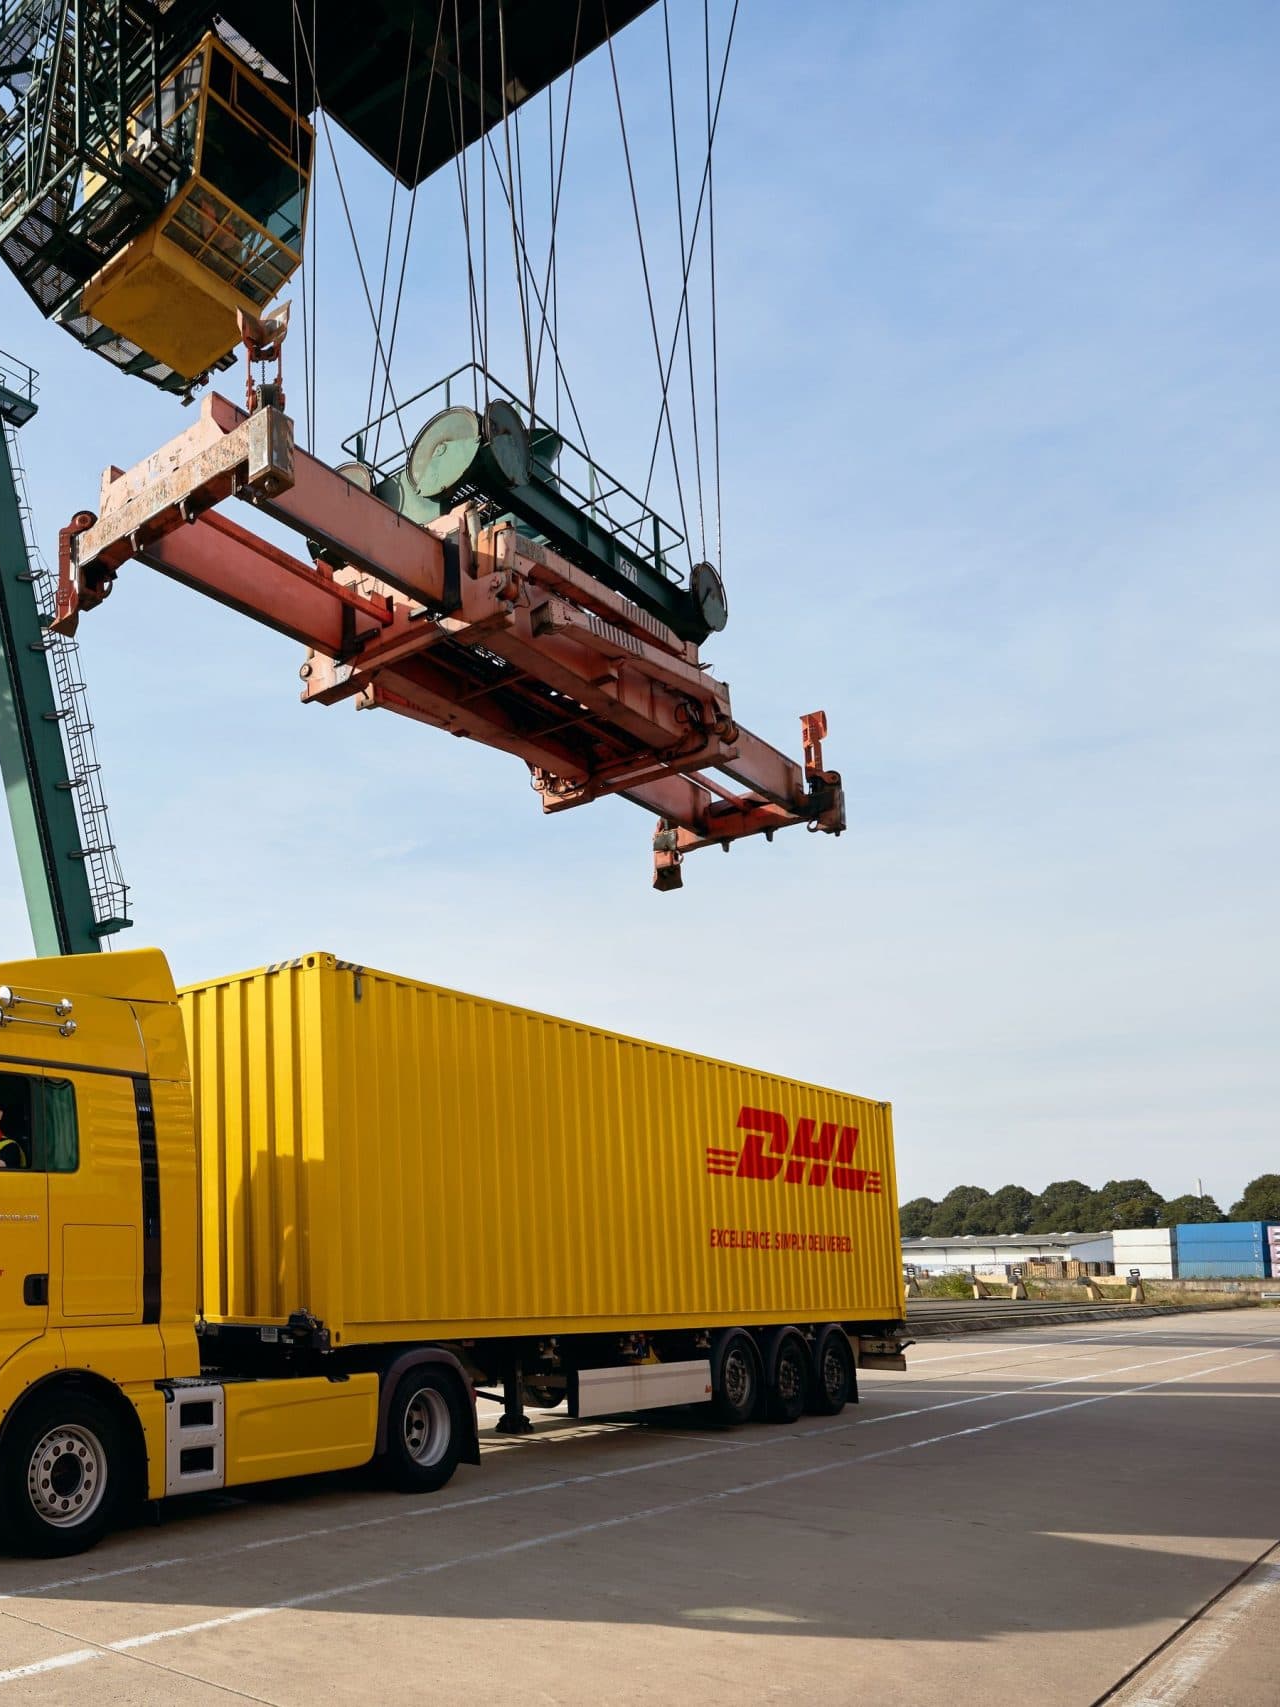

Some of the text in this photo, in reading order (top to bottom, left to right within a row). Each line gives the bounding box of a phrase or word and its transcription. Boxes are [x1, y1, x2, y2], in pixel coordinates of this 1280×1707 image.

[736, 1106, 868, 1193] DHL
[775, 1232, 807, 1250] SIMPLY
[808, 1234, 853, 1253] DELIVERED.
